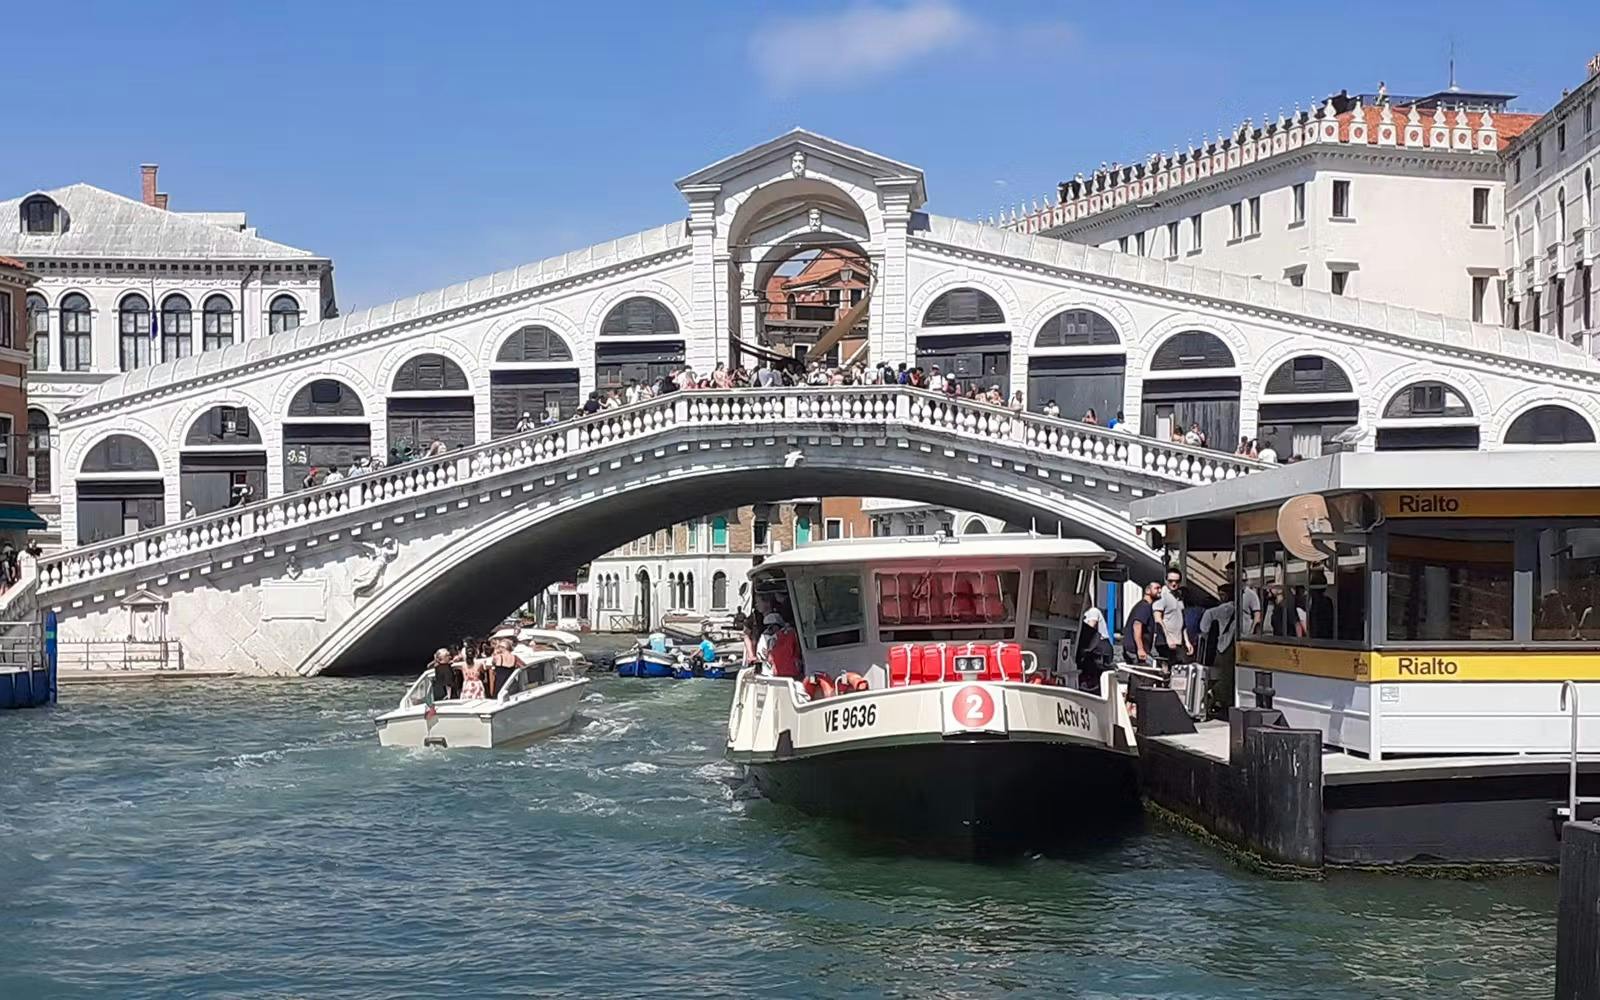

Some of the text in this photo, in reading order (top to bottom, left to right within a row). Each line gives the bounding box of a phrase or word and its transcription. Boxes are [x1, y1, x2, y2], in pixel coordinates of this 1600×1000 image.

[1399, 495, 1459, 513] Rialto
[1398, 657, 1458, 675] Rialto
[824, 703, 877, 733] VE 9636
[966, 695, 984, 719] 2
[1057, 702, 1079, 727] Actv
